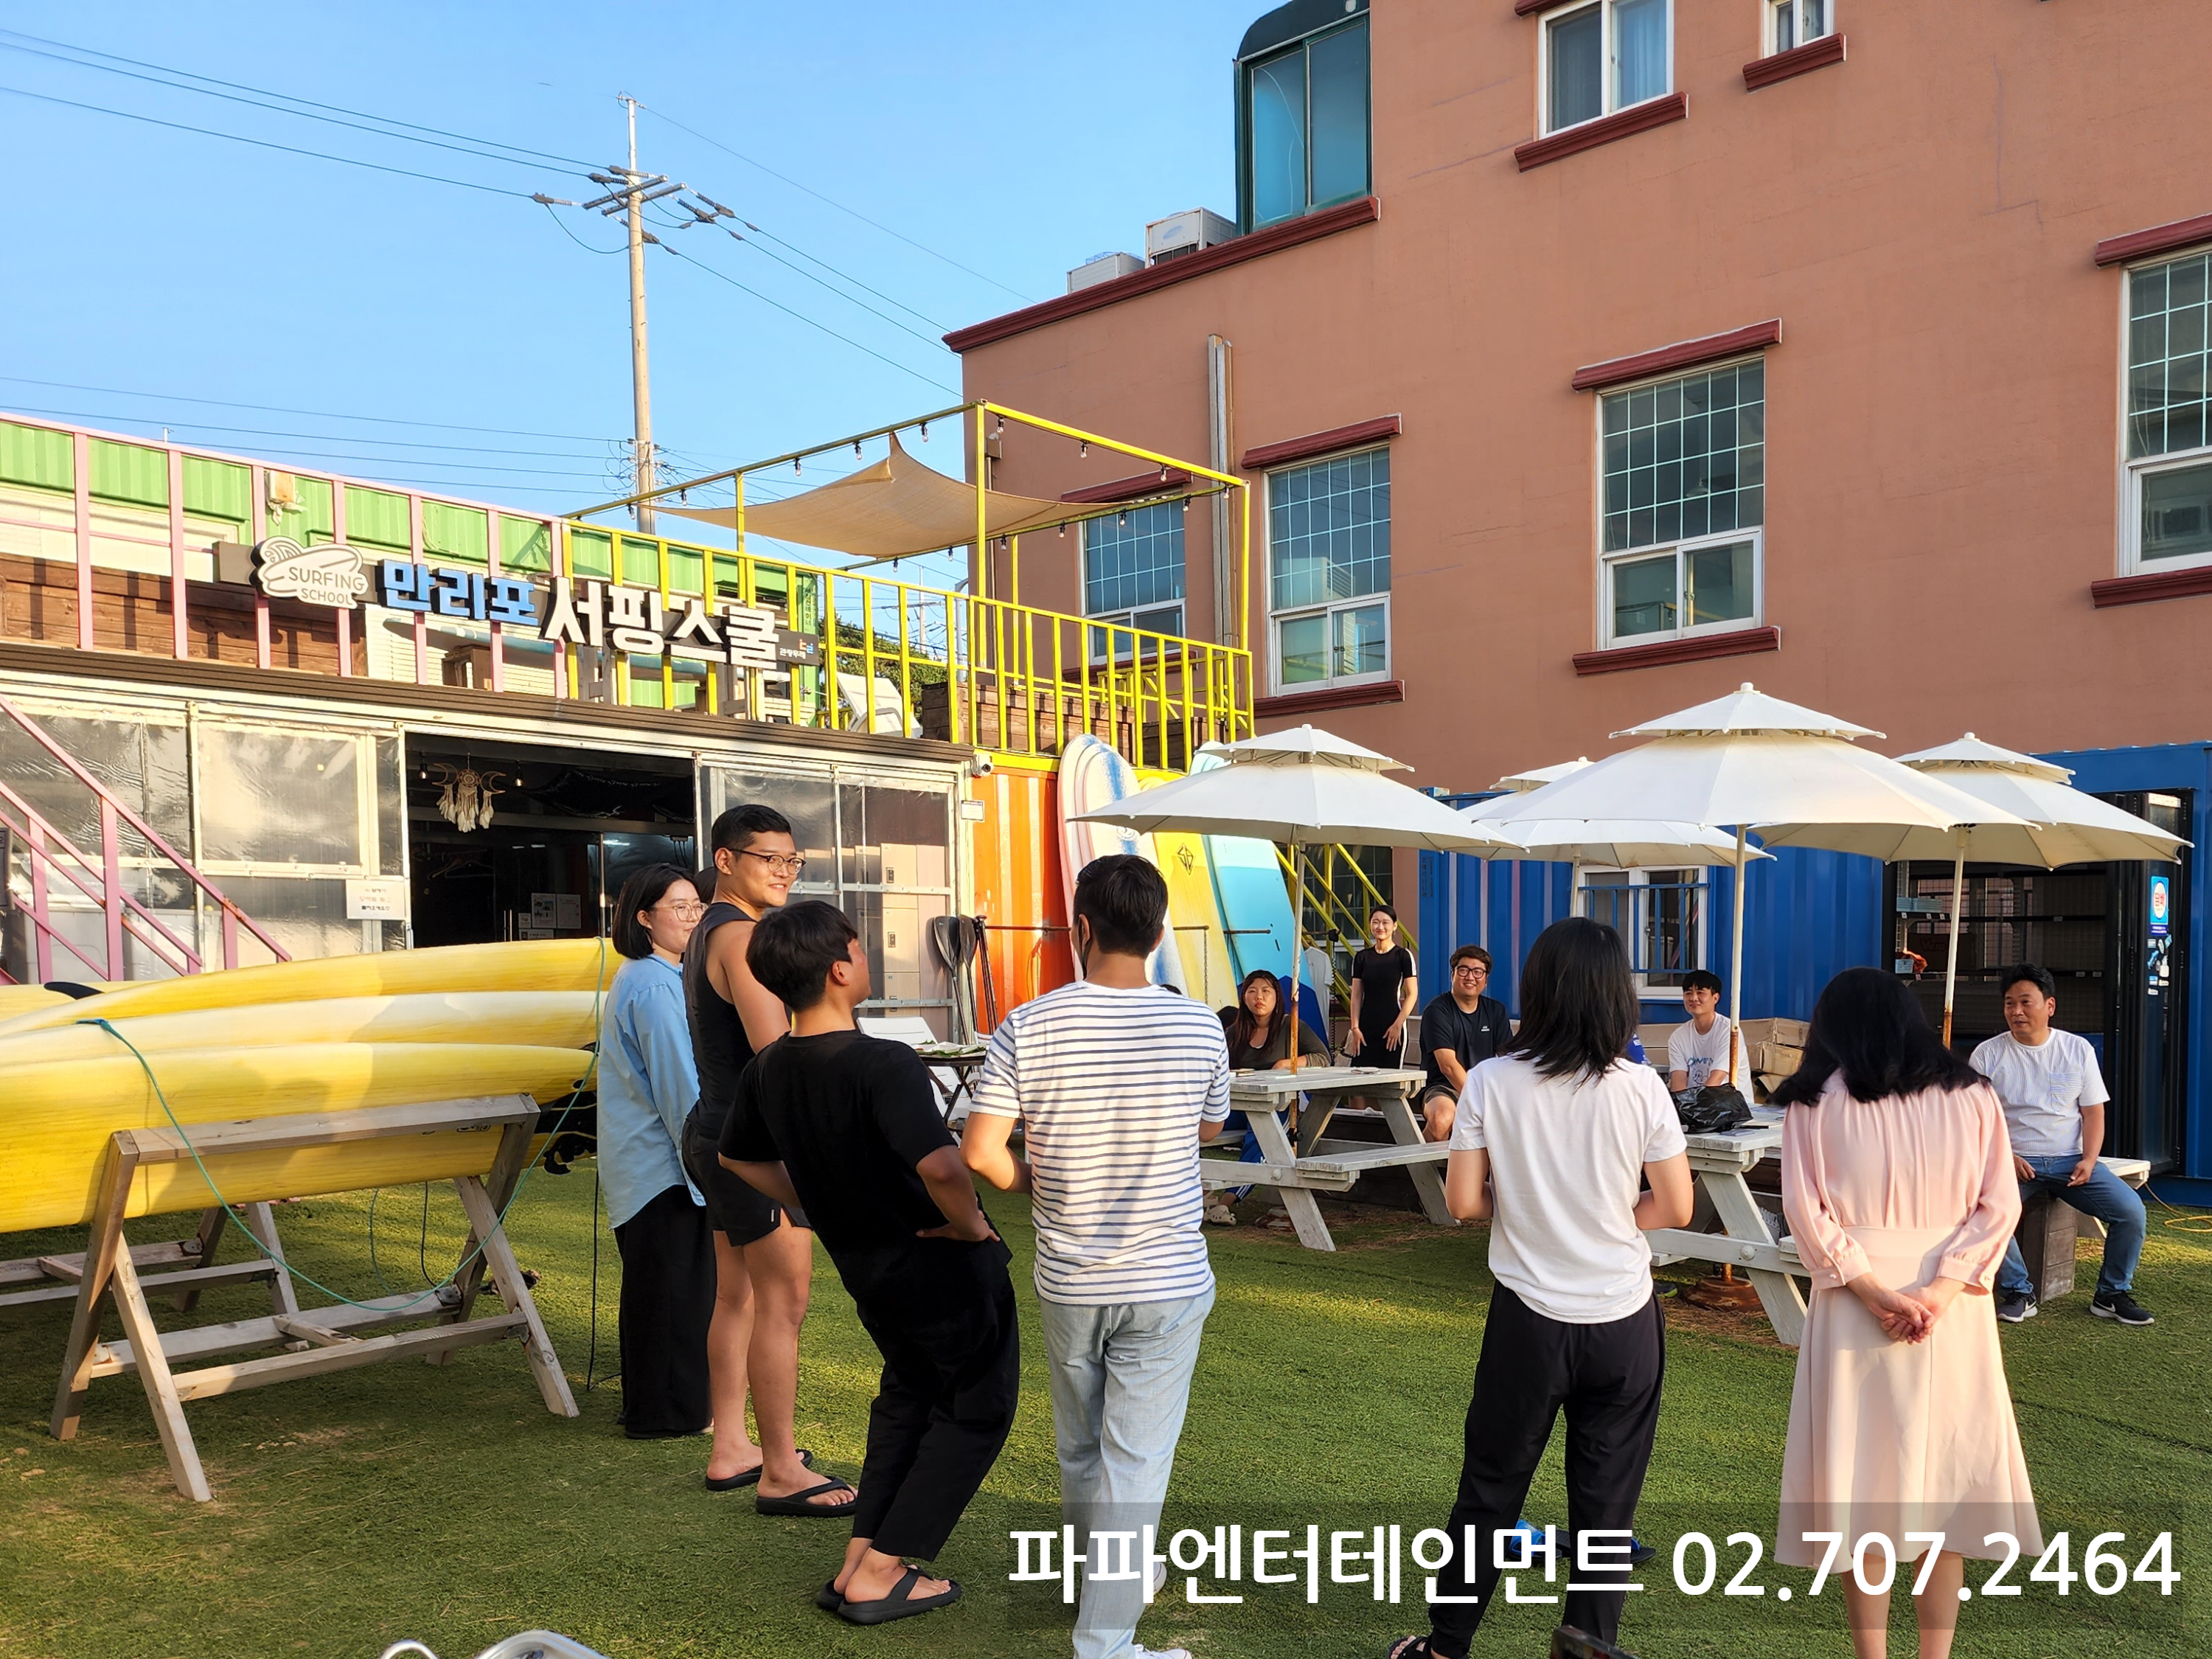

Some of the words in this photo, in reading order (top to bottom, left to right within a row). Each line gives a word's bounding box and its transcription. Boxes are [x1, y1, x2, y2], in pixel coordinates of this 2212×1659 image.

[288, 566, 365, 591] SURFING
[301, 588, 353, 605] SCHOOL
[383, 559, 539, 627] 만리포
[543, 576, 779, 669] 서핑스쿨
